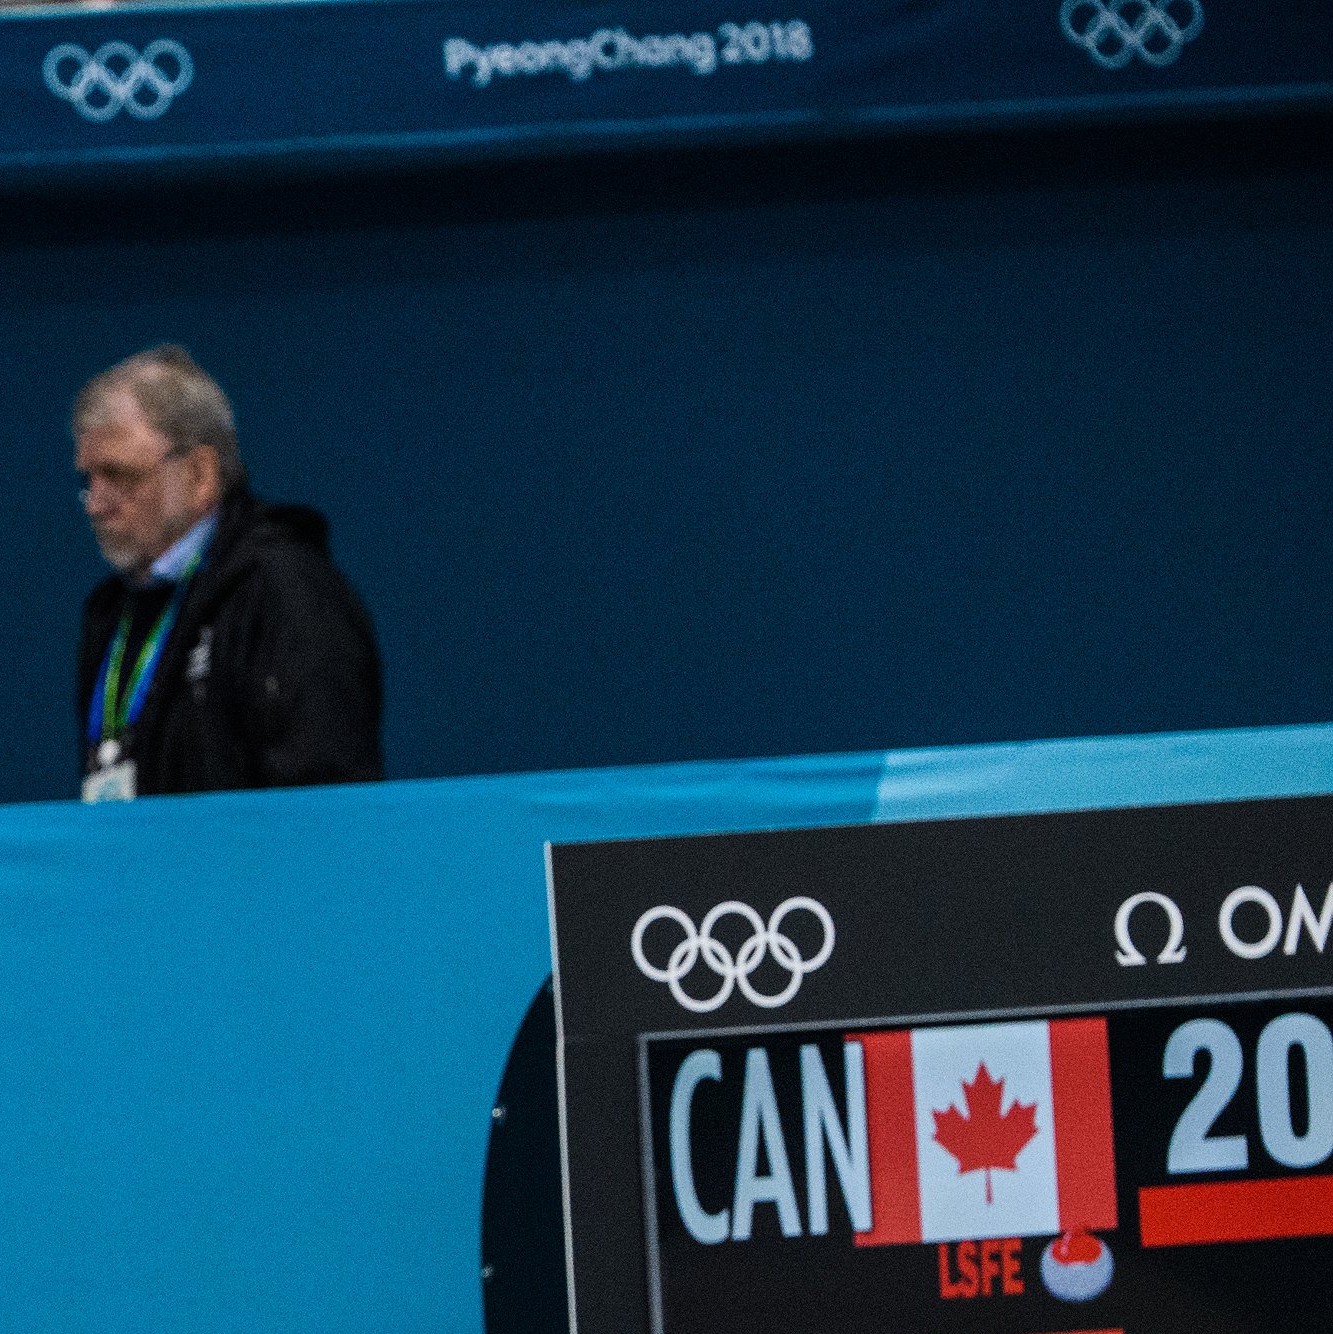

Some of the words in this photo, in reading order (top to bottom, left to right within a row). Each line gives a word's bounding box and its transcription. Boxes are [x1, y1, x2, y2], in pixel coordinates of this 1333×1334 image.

[443, 25, 716, 88] PyeongChang
[717, 18, 814, 65] 2018
[670, 1040, 874, 1246] CAN
[939, 1239, 1025, 1299] LSFE
